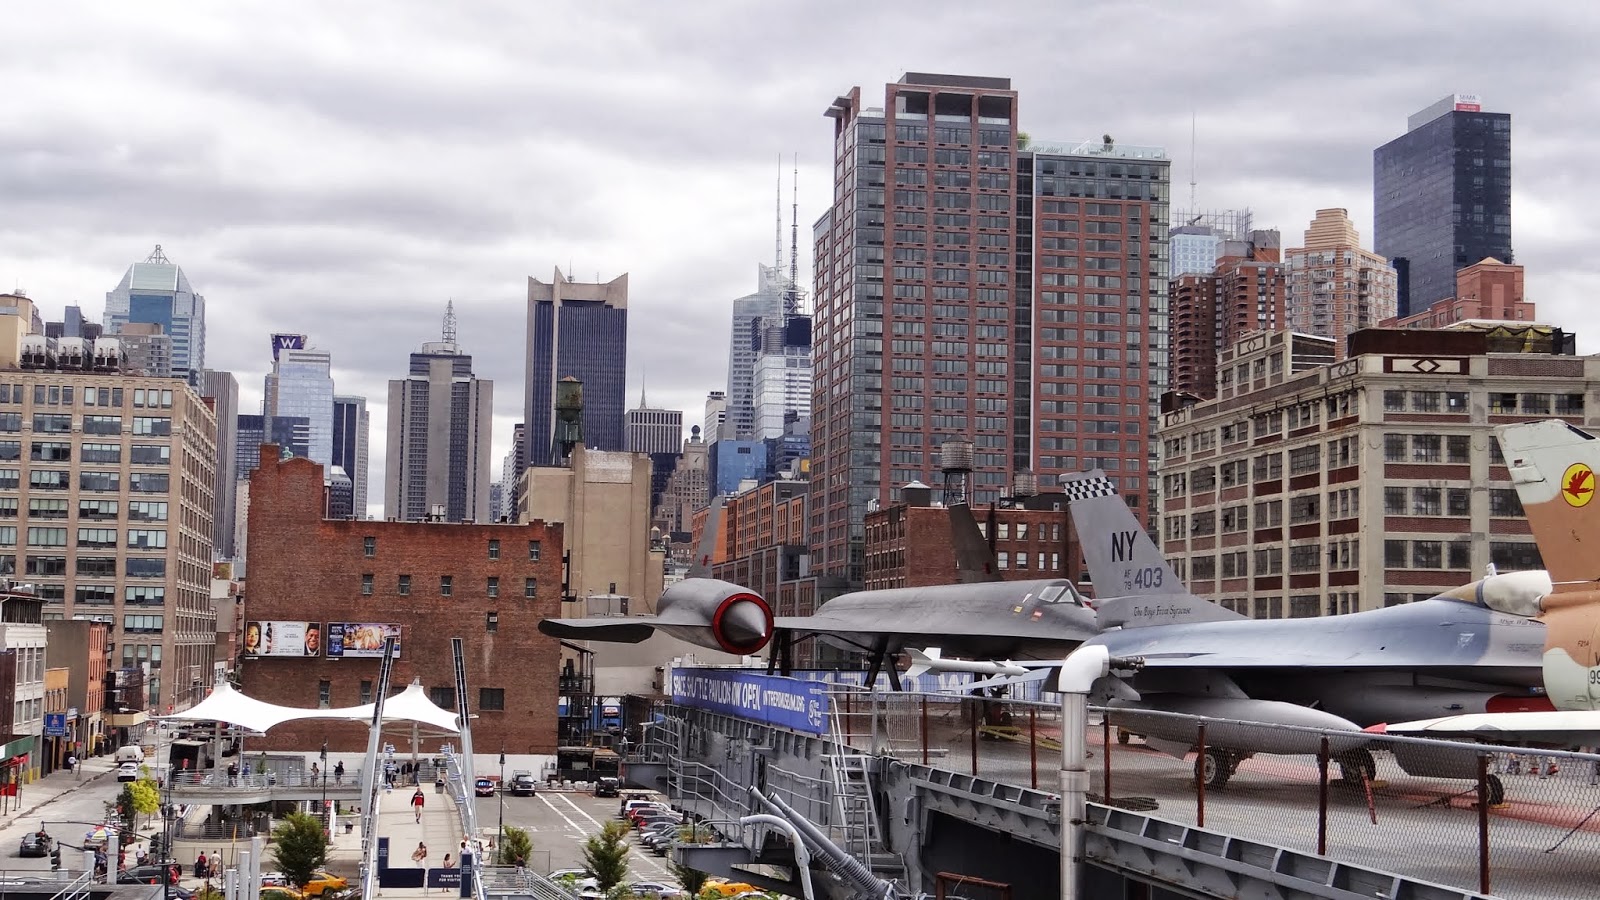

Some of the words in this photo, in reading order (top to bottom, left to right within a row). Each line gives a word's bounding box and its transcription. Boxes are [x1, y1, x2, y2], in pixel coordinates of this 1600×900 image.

[280, 338, 296, 349] W
[1112, 531, 1138, 562] NY
[1124, 569, 1132, 578] AF
[1134, 567, 1163, 589] 403
[673, 675, 686, 697] SPACE
[742, 682, 761, 711] OPEN
